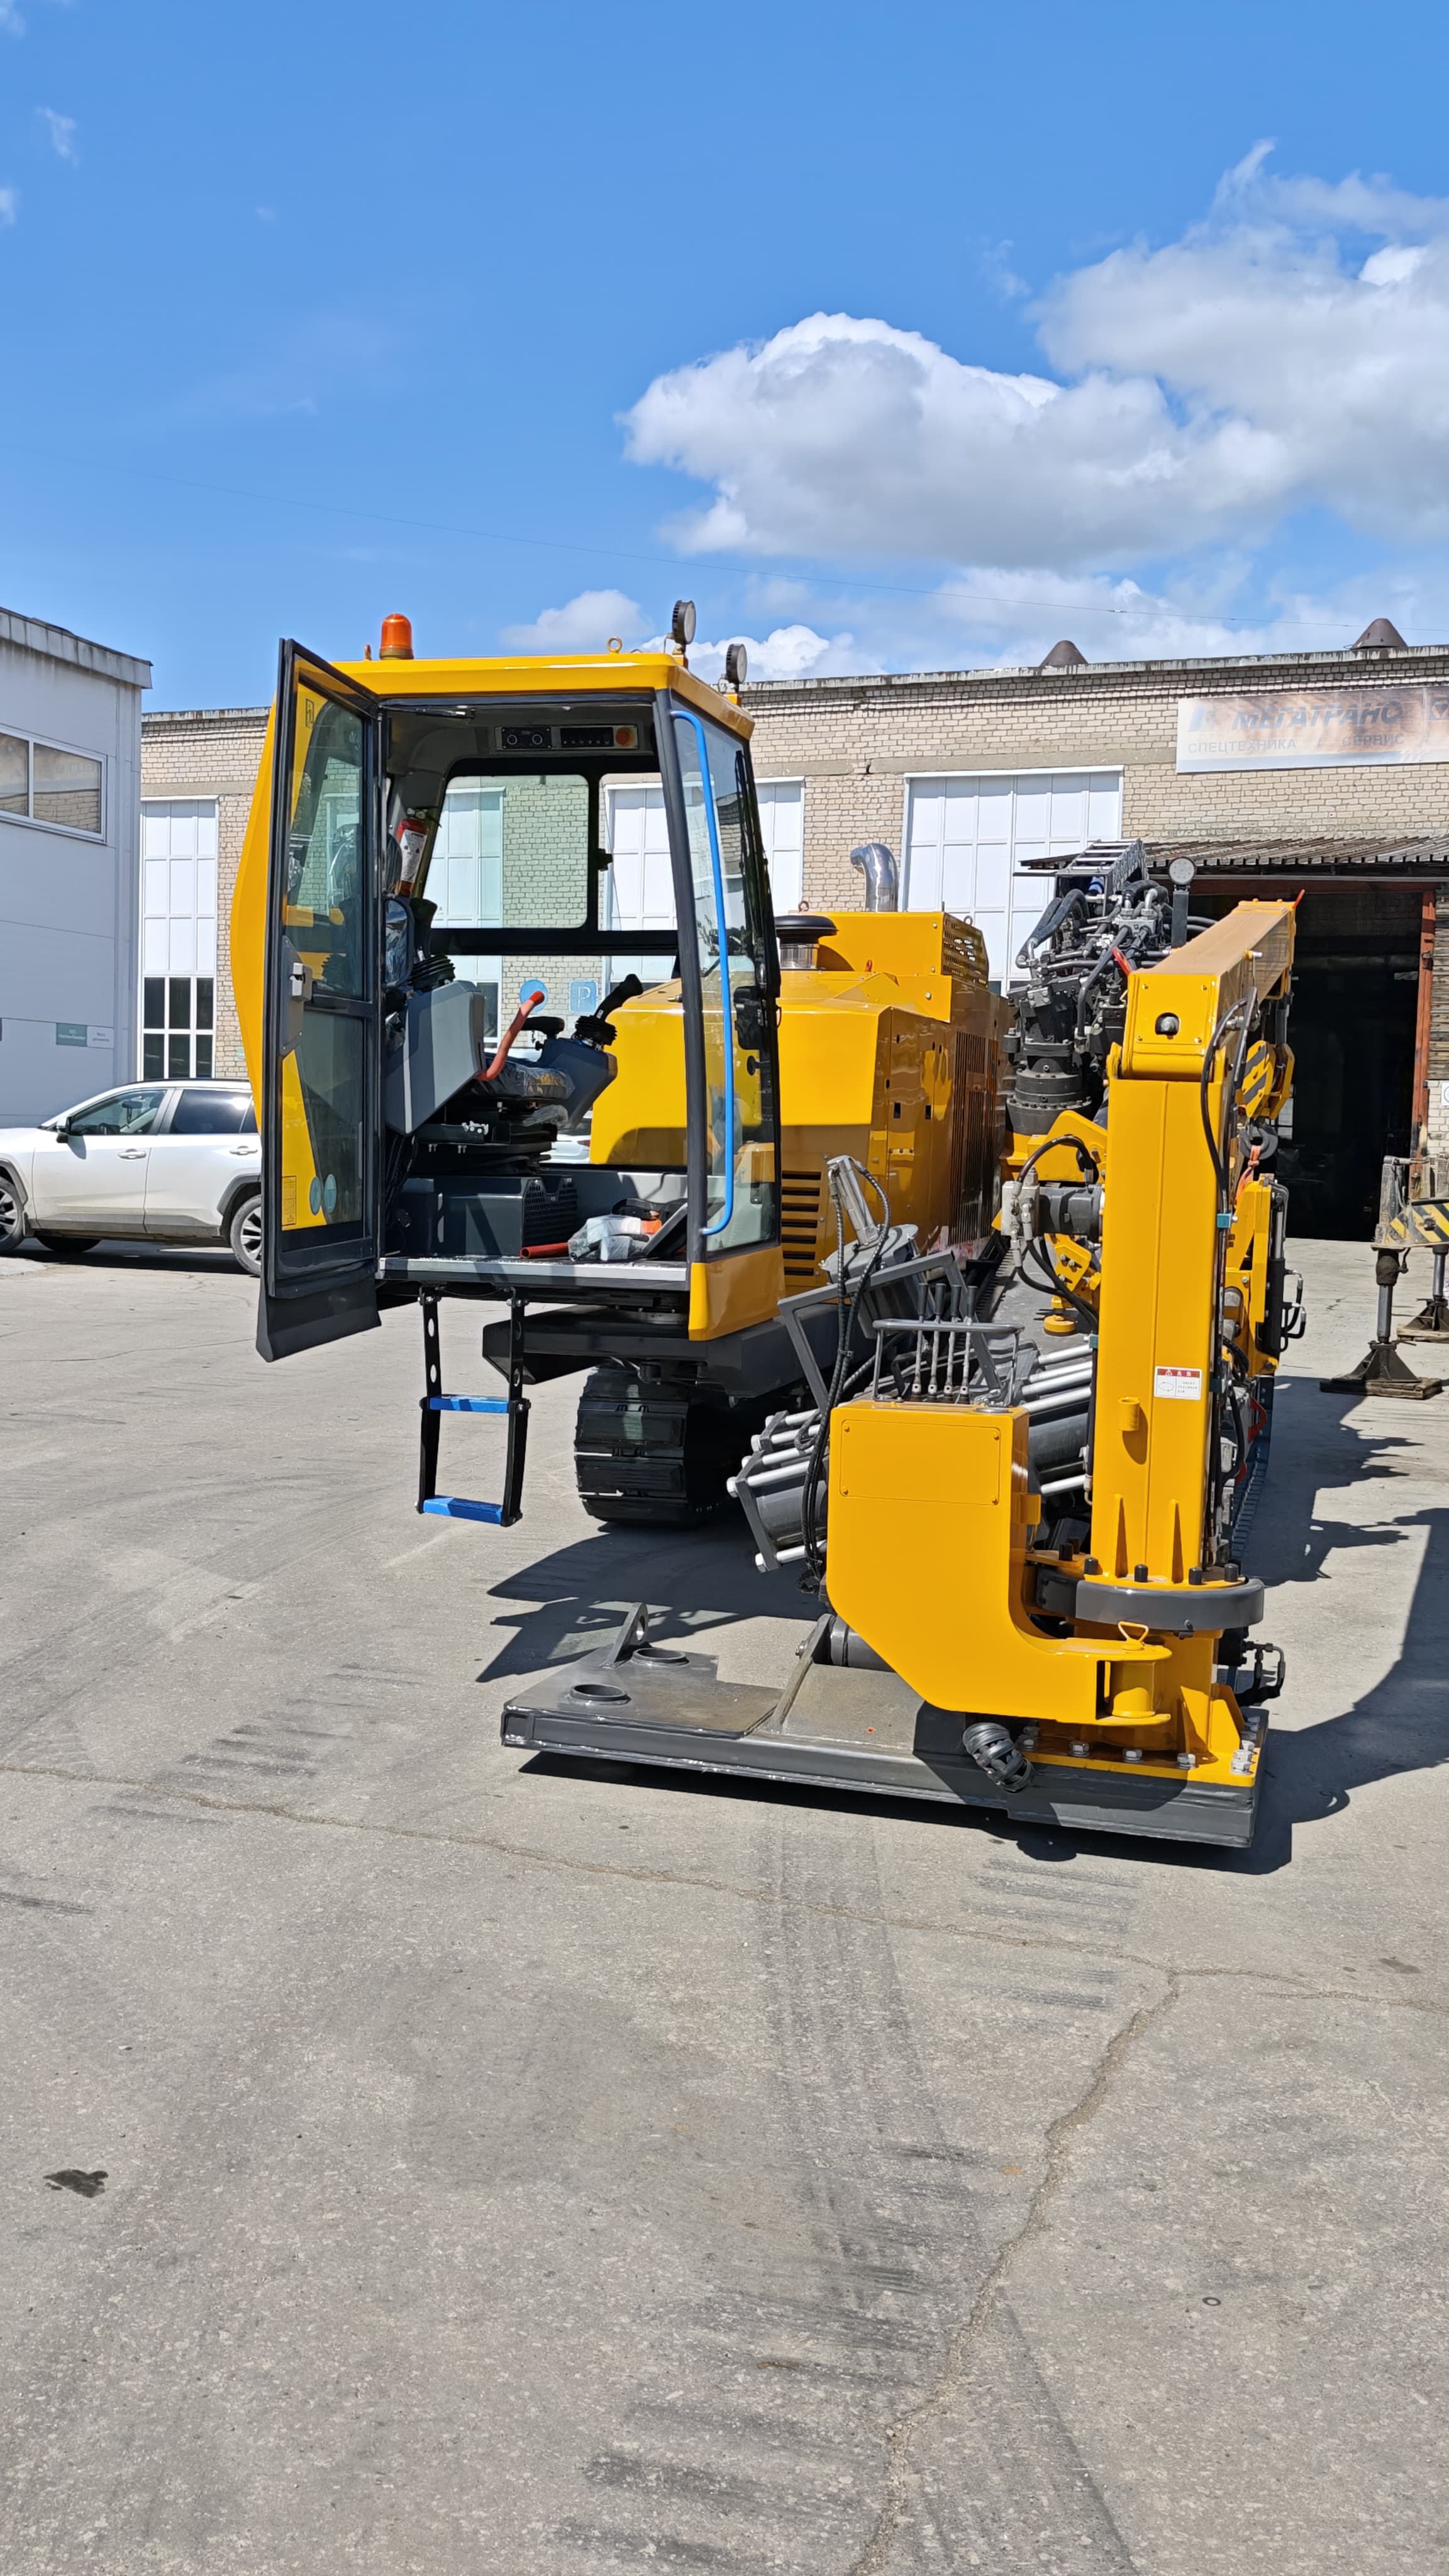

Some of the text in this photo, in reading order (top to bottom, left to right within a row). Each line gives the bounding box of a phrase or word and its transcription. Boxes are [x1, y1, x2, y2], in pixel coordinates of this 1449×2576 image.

[1231, 701, 1404, 731] МЕГАТРАНС
[1188, 733, 1404, 755] СПЕЦТЕХНИКА СЕРВИС
